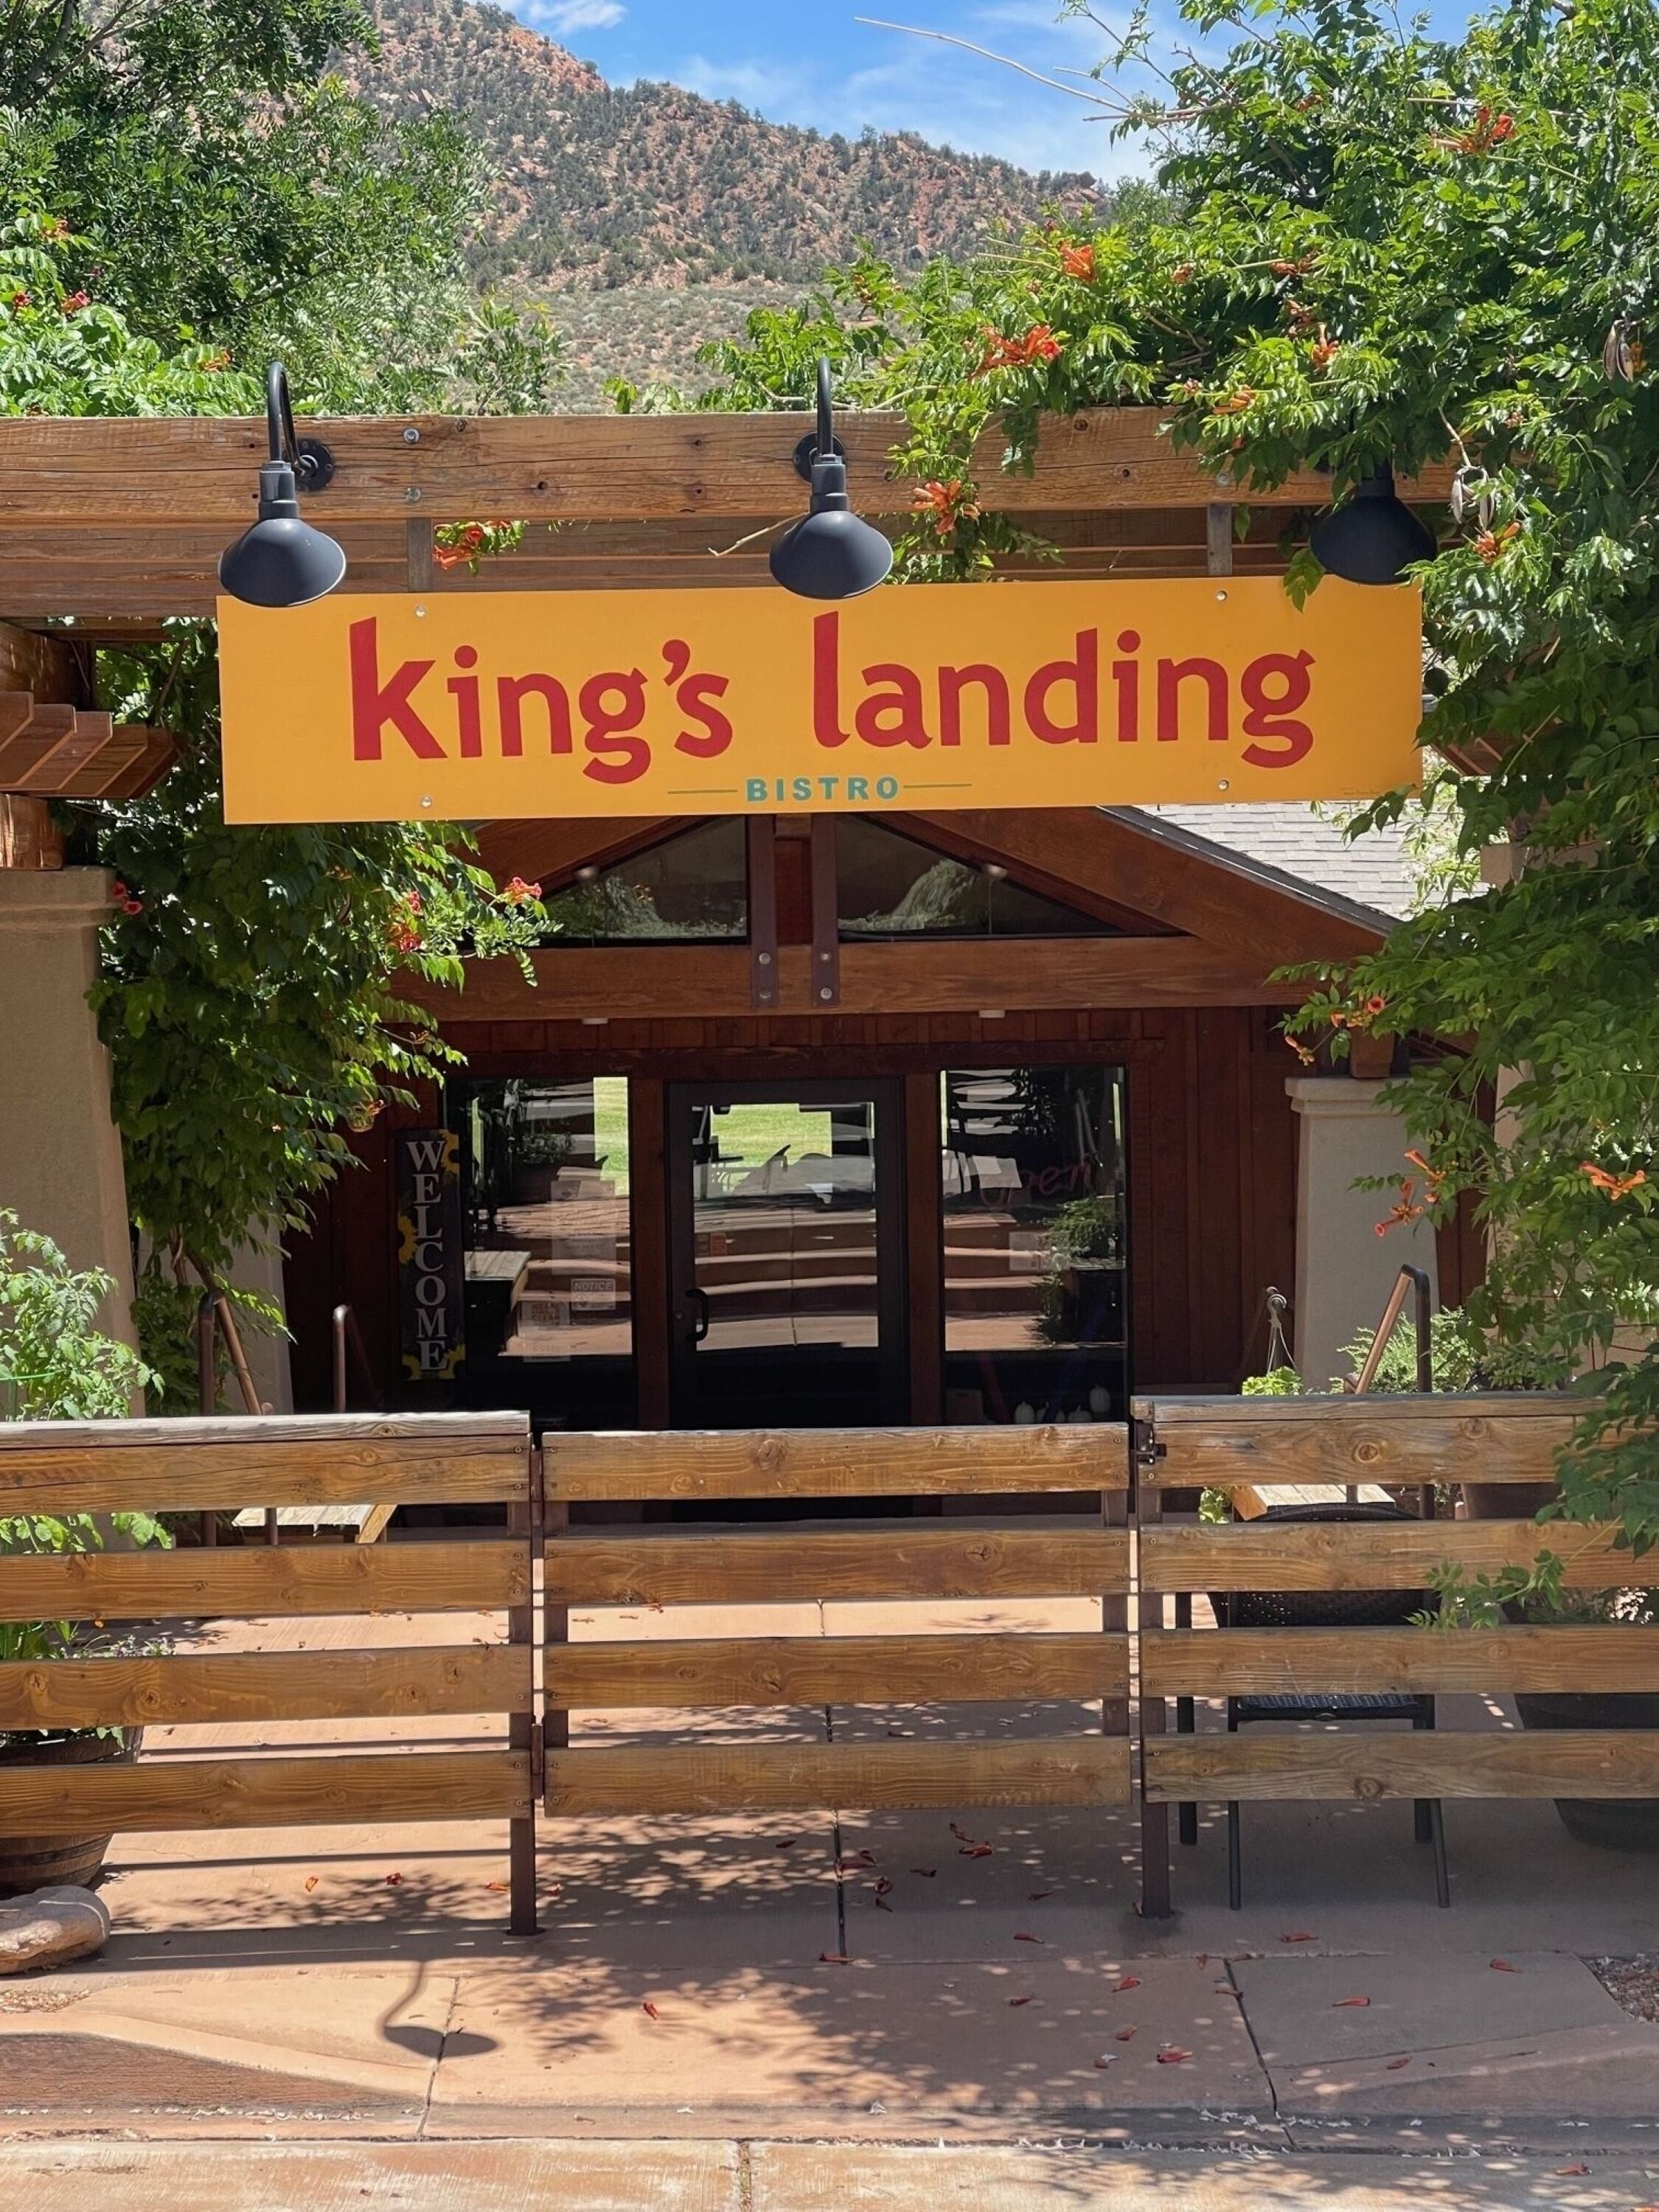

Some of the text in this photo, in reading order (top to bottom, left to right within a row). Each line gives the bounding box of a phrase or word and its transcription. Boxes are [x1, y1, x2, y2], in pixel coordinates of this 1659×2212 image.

[349, 611, 1315, 784] king's landing
[745, 776, 900, 801] BISTRO
[406, 1140, 449, 1371] WELCOME
[574, 1281, 613, 1291] NOTICE
